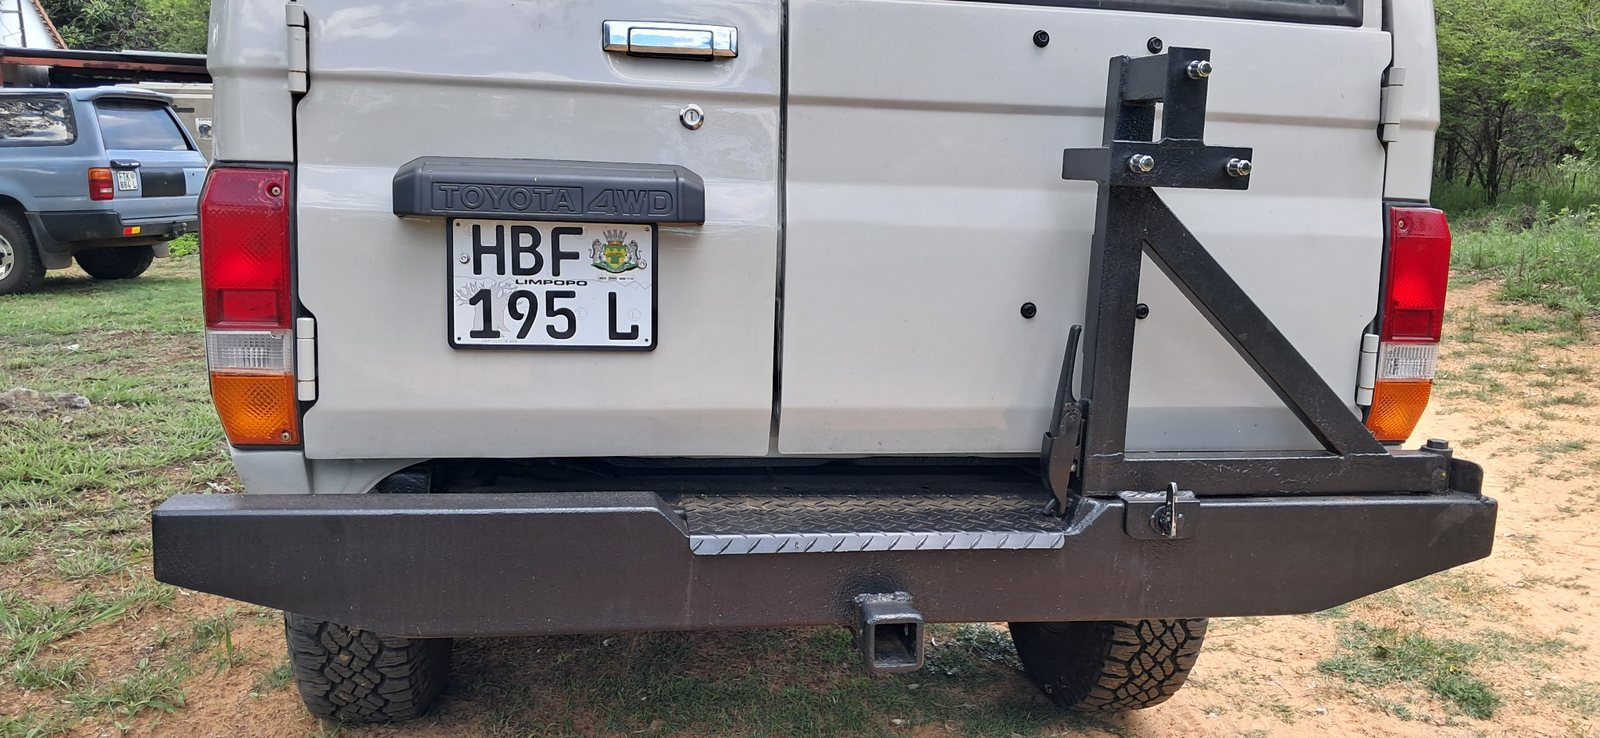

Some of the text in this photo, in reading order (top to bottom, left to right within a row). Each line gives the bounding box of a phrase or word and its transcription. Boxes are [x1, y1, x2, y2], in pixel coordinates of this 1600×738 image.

[439, 185, 674, 217] TOYOTA 4WD
[472, 224, 584, 277] HBF
[515, 278, 588, 287] LIMPOPO
[469, 288, 640, 341] 195 L
